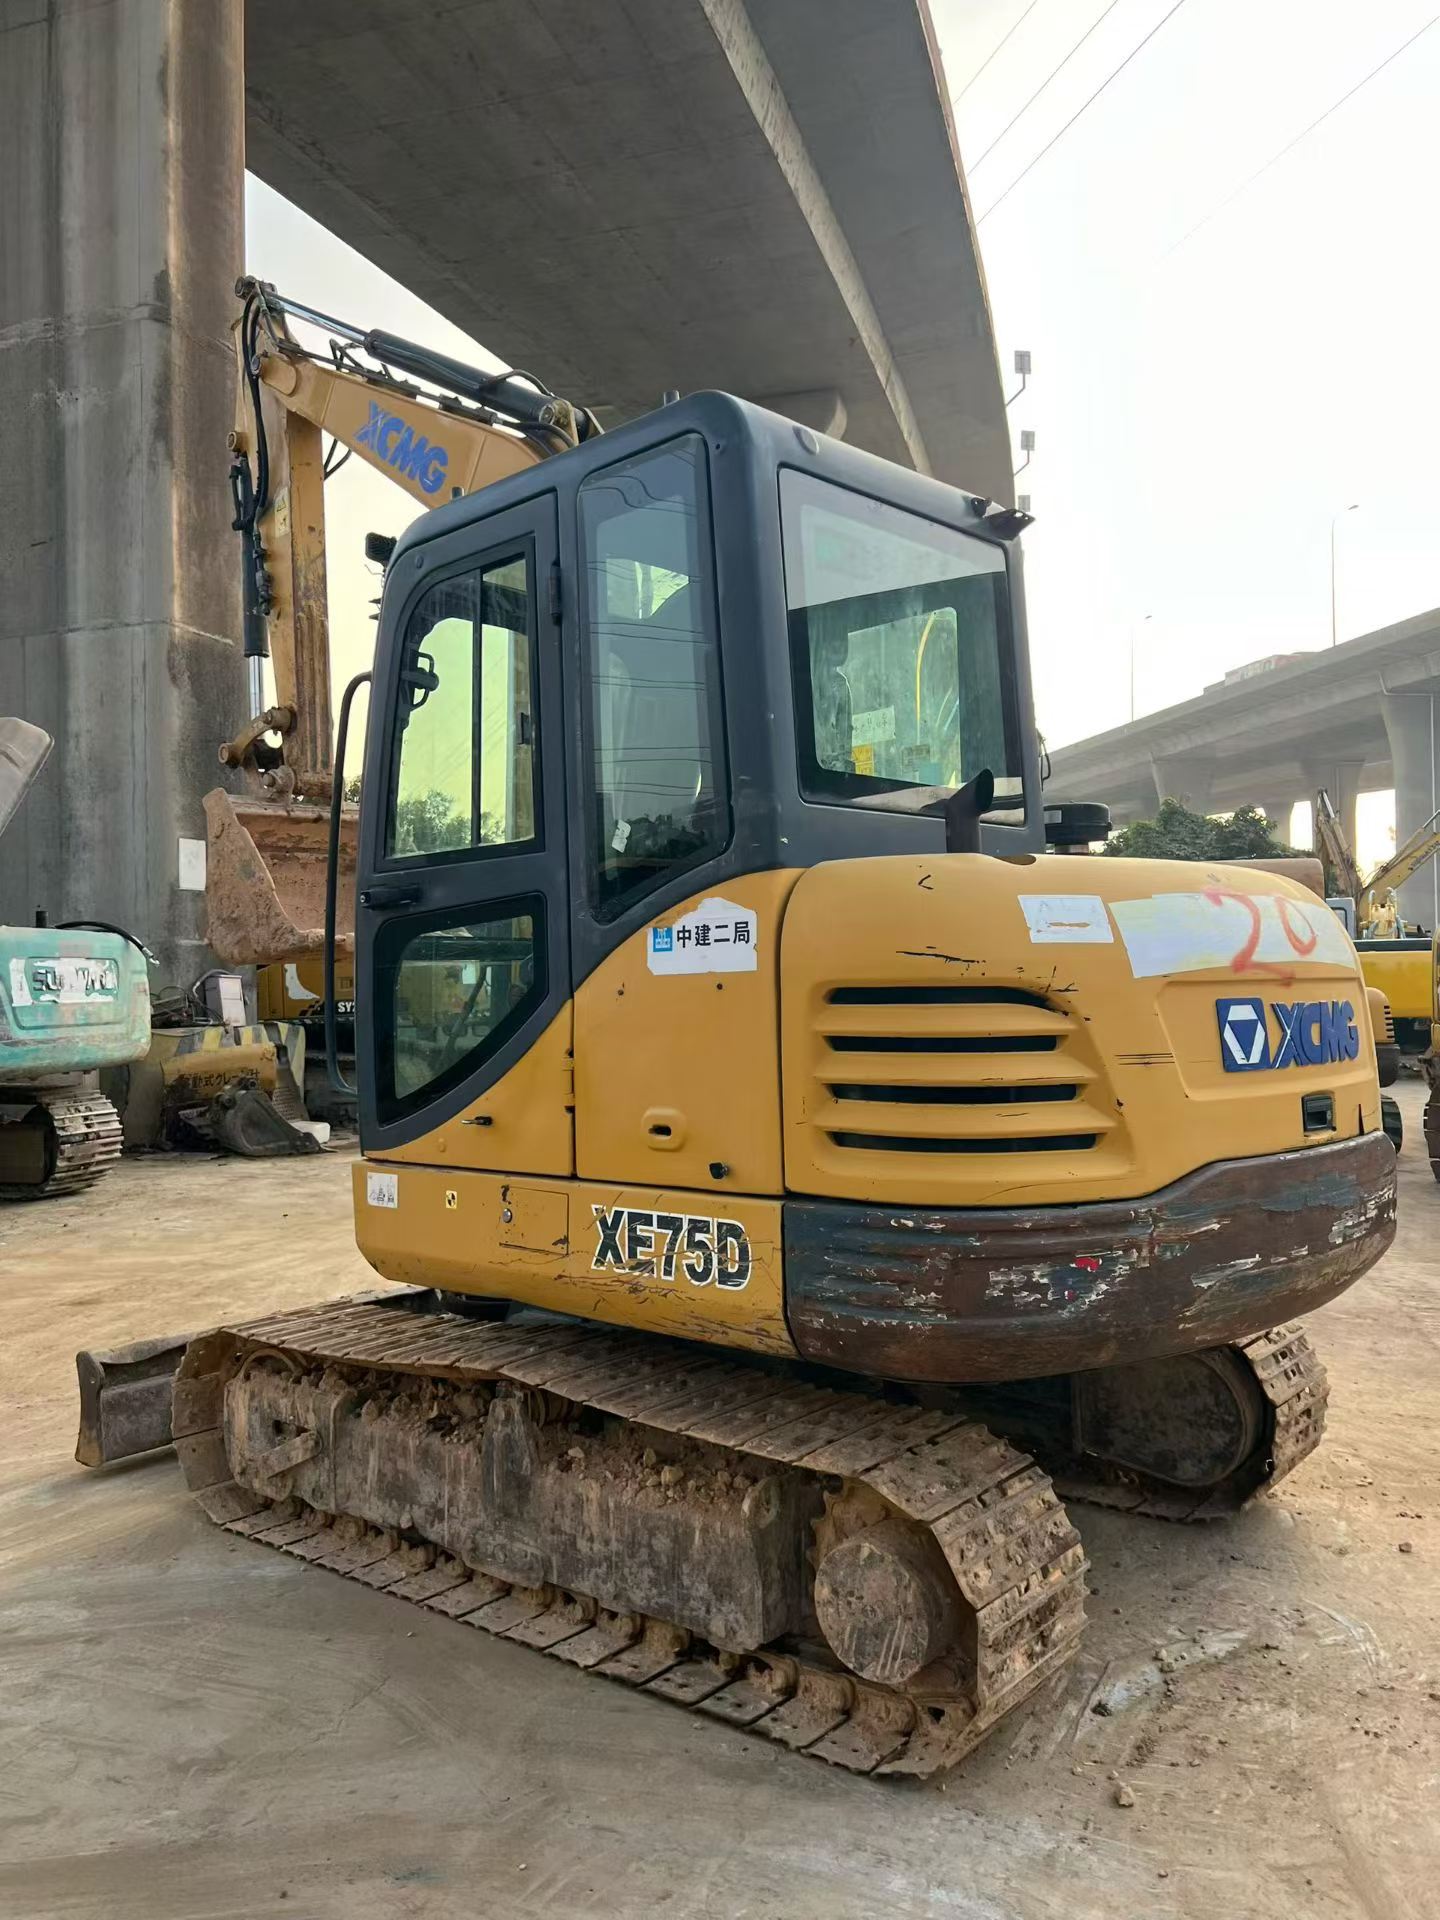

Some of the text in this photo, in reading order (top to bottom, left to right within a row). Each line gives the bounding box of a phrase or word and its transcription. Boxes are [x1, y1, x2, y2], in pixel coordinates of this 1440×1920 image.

[353, 399, 449, 495] XCMG
[676, 920, 751, 949] 中建二局
[1202, 887, 1318, 988] 20
[1270, 999, 1360, 1069] XCMG
[590, 1203, 753, 1291] XE75D
